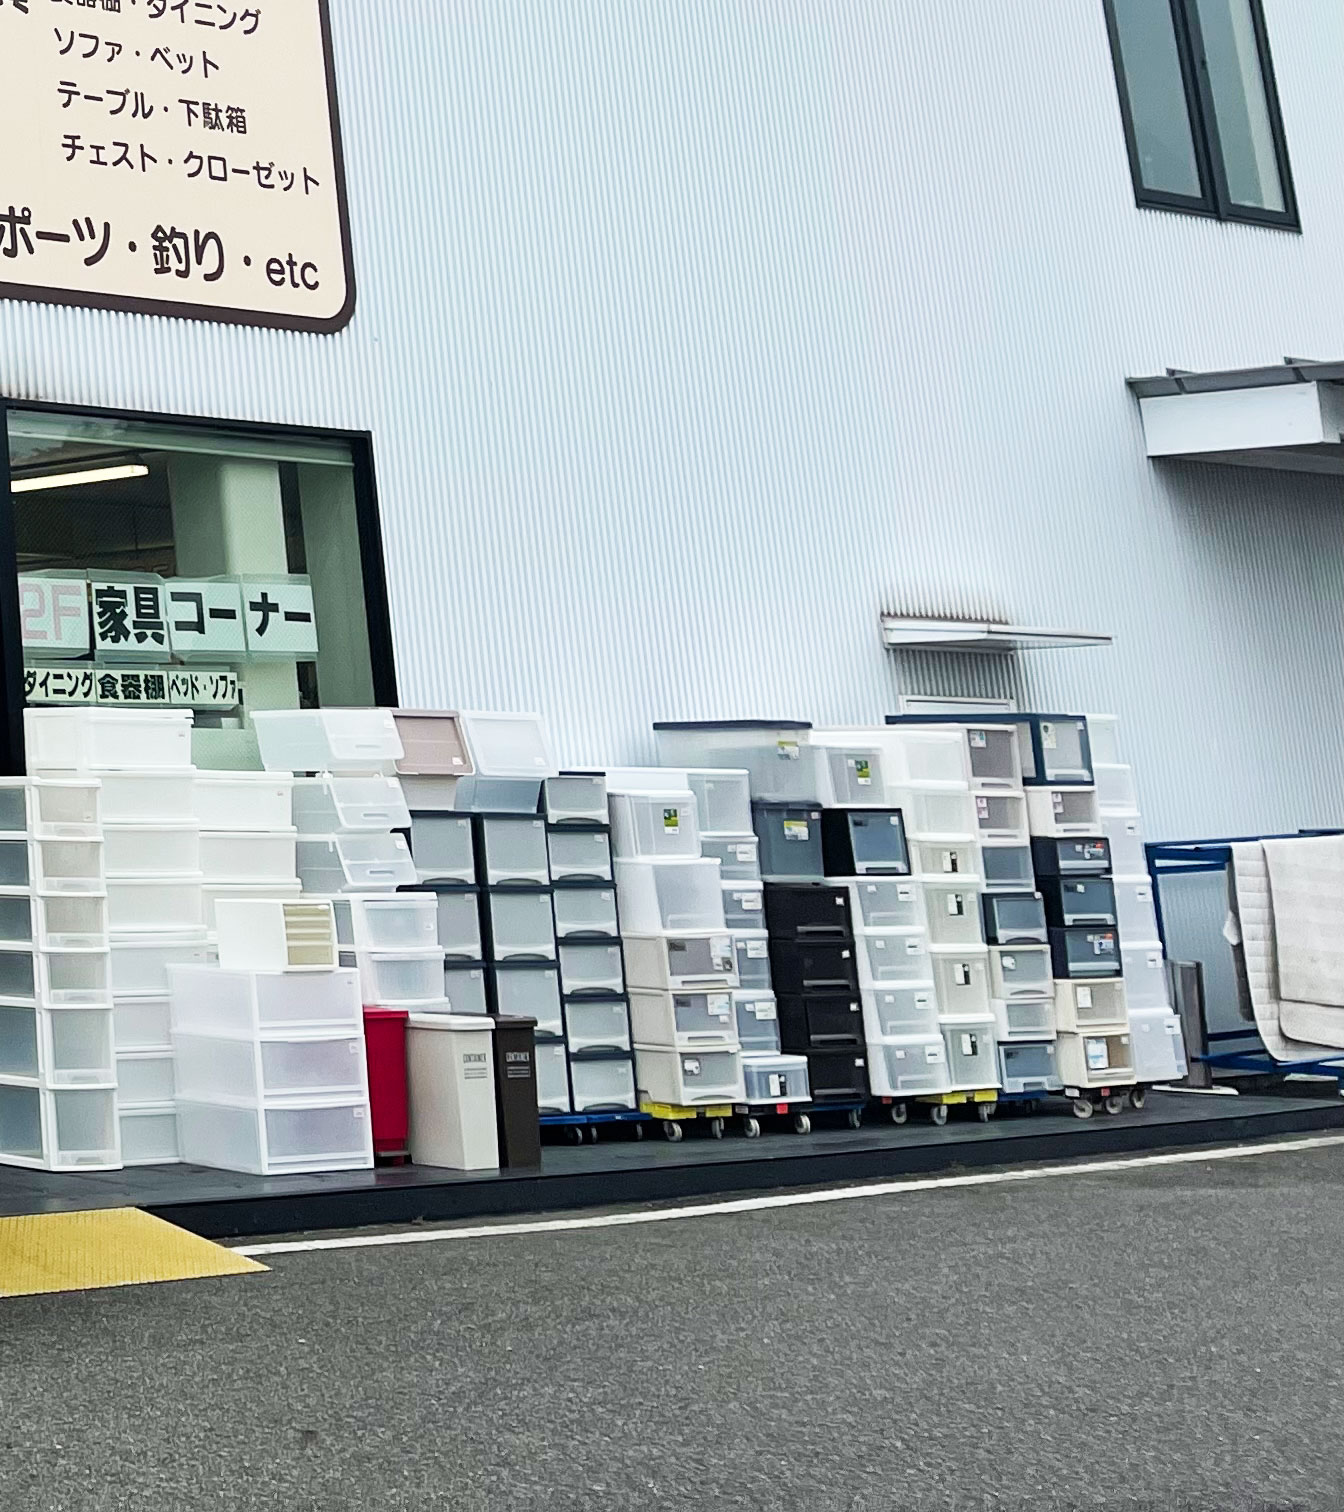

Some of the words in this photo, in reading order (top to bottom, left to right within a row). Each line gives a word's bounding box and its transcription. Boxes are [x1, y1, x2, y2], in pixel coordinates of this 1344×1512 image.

[18, 583, 82, 640] 2F
[95, 586, 311, 645] 家具コーナー
[98, 673, 165, 700] 食器棚
